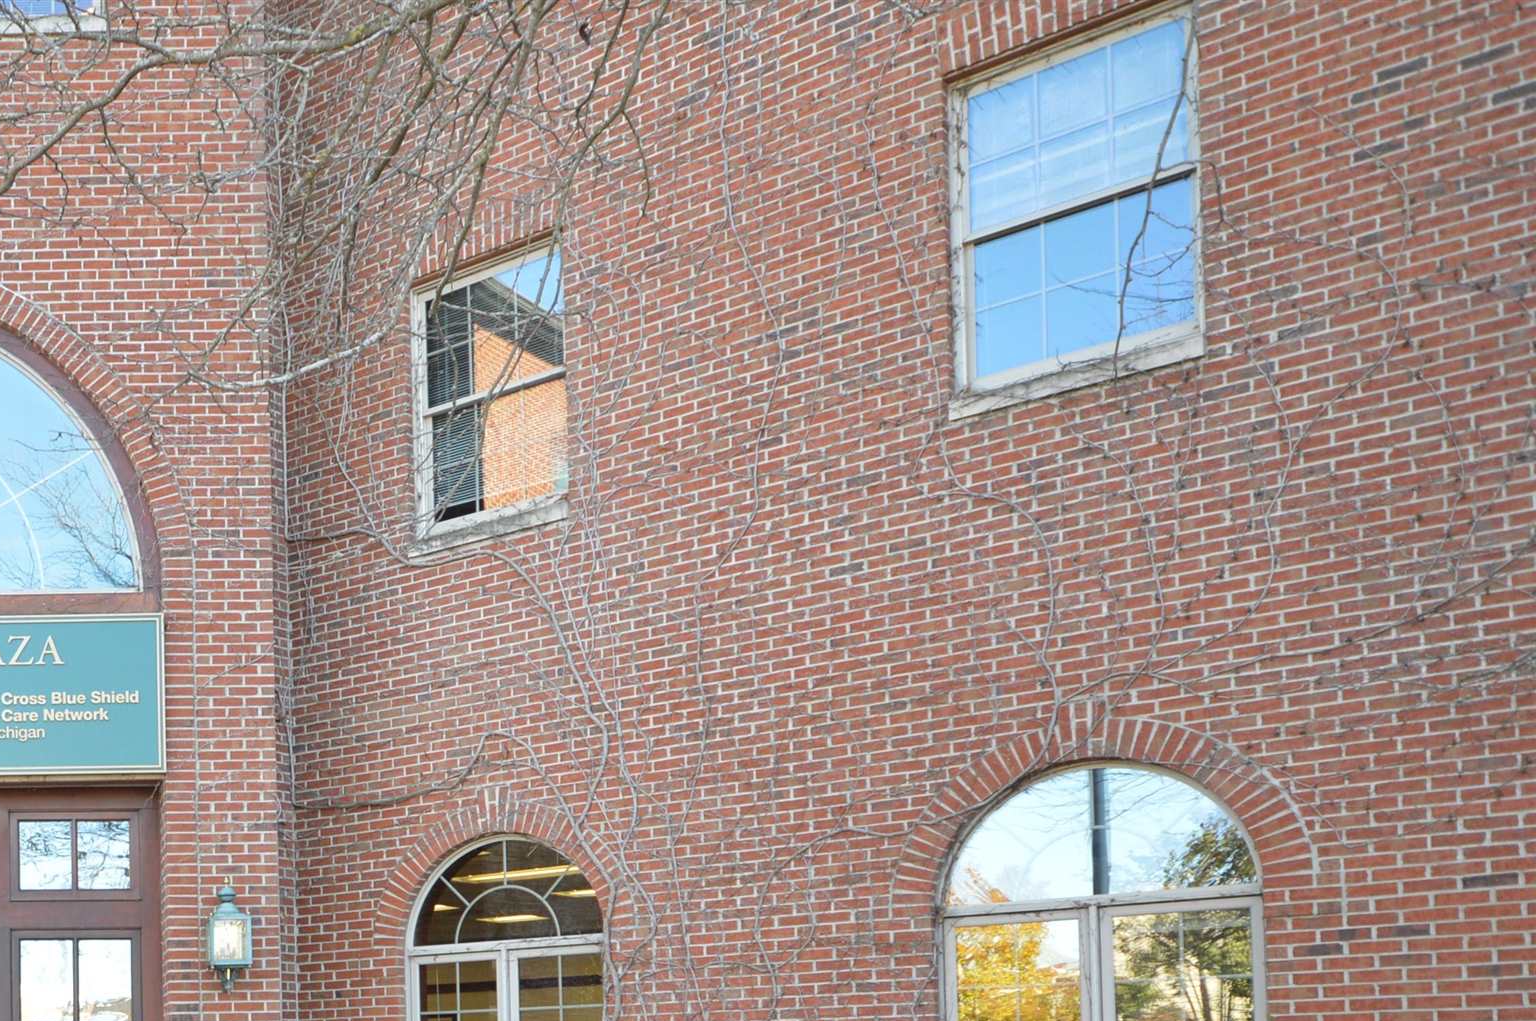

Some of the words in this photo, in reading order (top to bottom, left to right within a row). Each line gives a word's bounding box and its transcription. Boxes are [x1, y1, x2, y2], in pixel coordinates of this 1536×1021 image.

[1, 692, 47, 706] Cross
[50, 691, 87, 705] Blue
[90, 690, 140, 704] Shield
[1, 709, 39, 723] Care
[42, 708, 109, 722] Network
